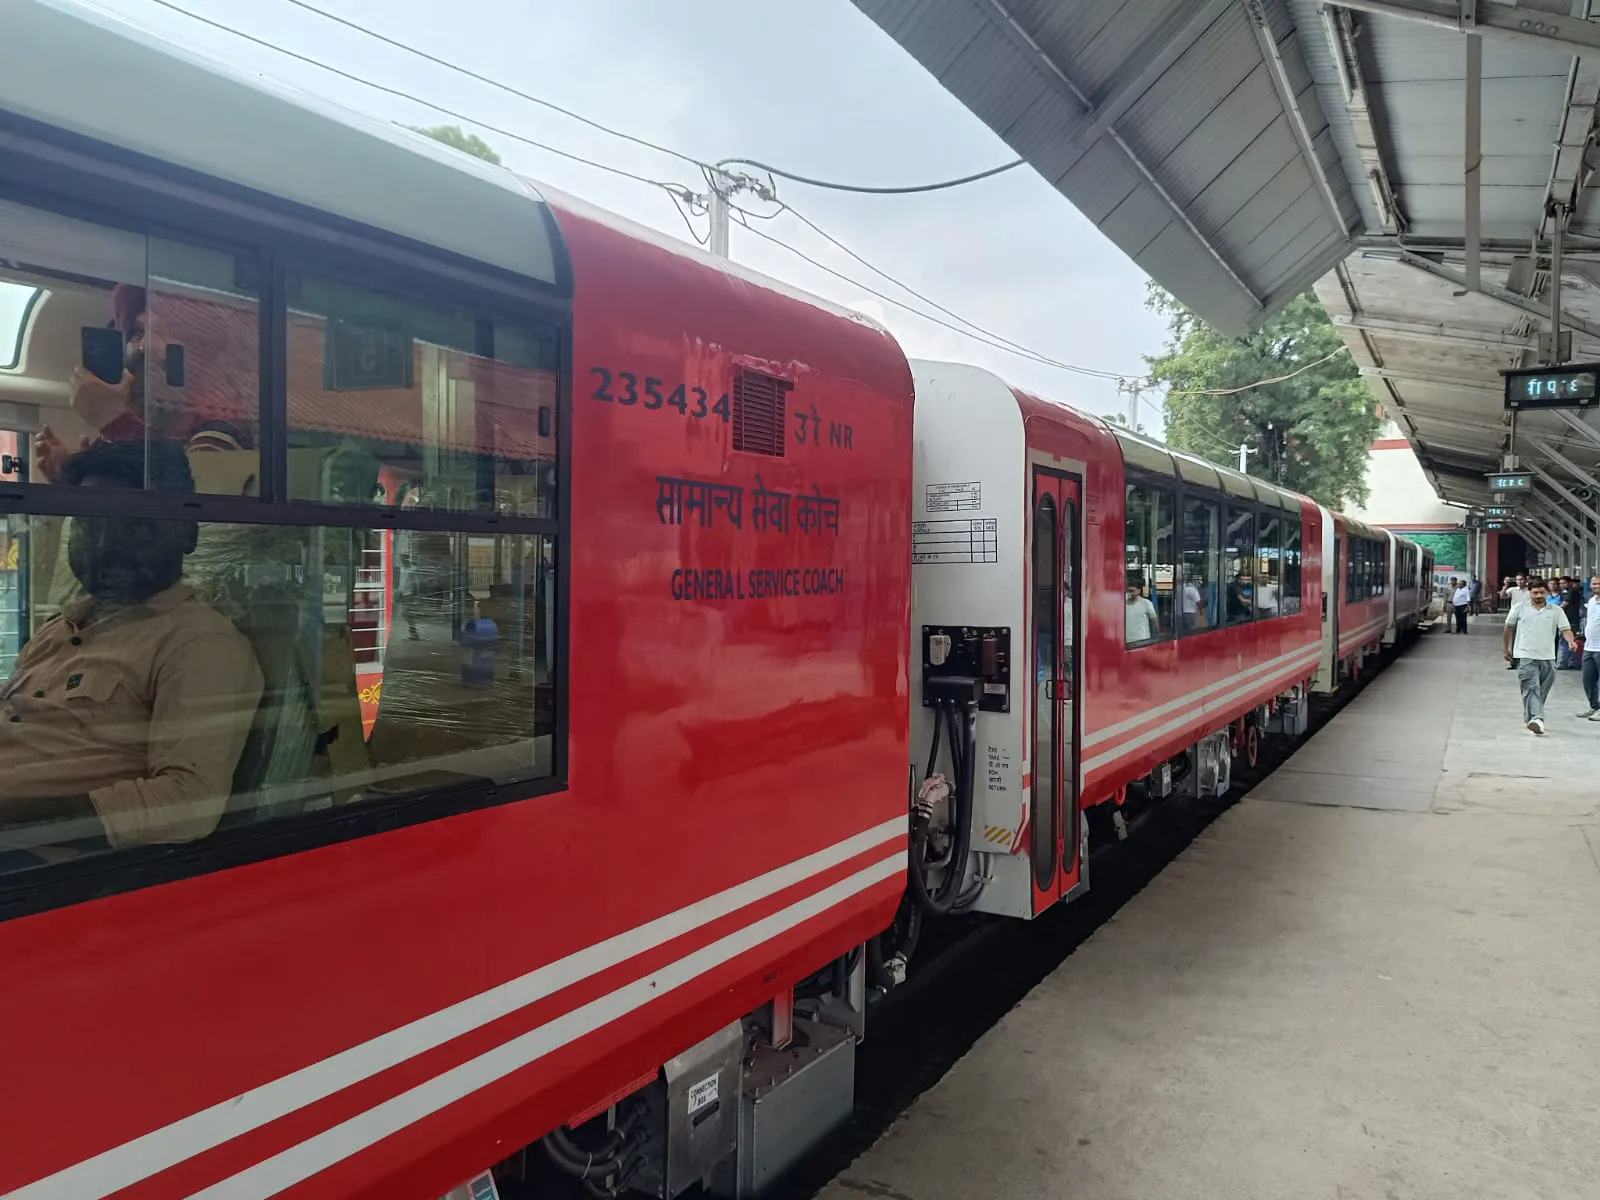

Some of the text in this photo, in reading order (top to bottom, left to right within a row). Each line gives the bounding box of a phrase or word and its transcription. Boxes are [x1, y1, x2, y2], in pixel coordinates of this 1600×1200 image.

[590, 366, 731, 422] 235434
[830, 420, 853, 450] NR
[655, 473, 841, 536] सामान्य सेवा कोच
[671, 568, 844, 600] GENERAL SERVICE COACH
[690, 1079, 717, 1099] CONNECTION
